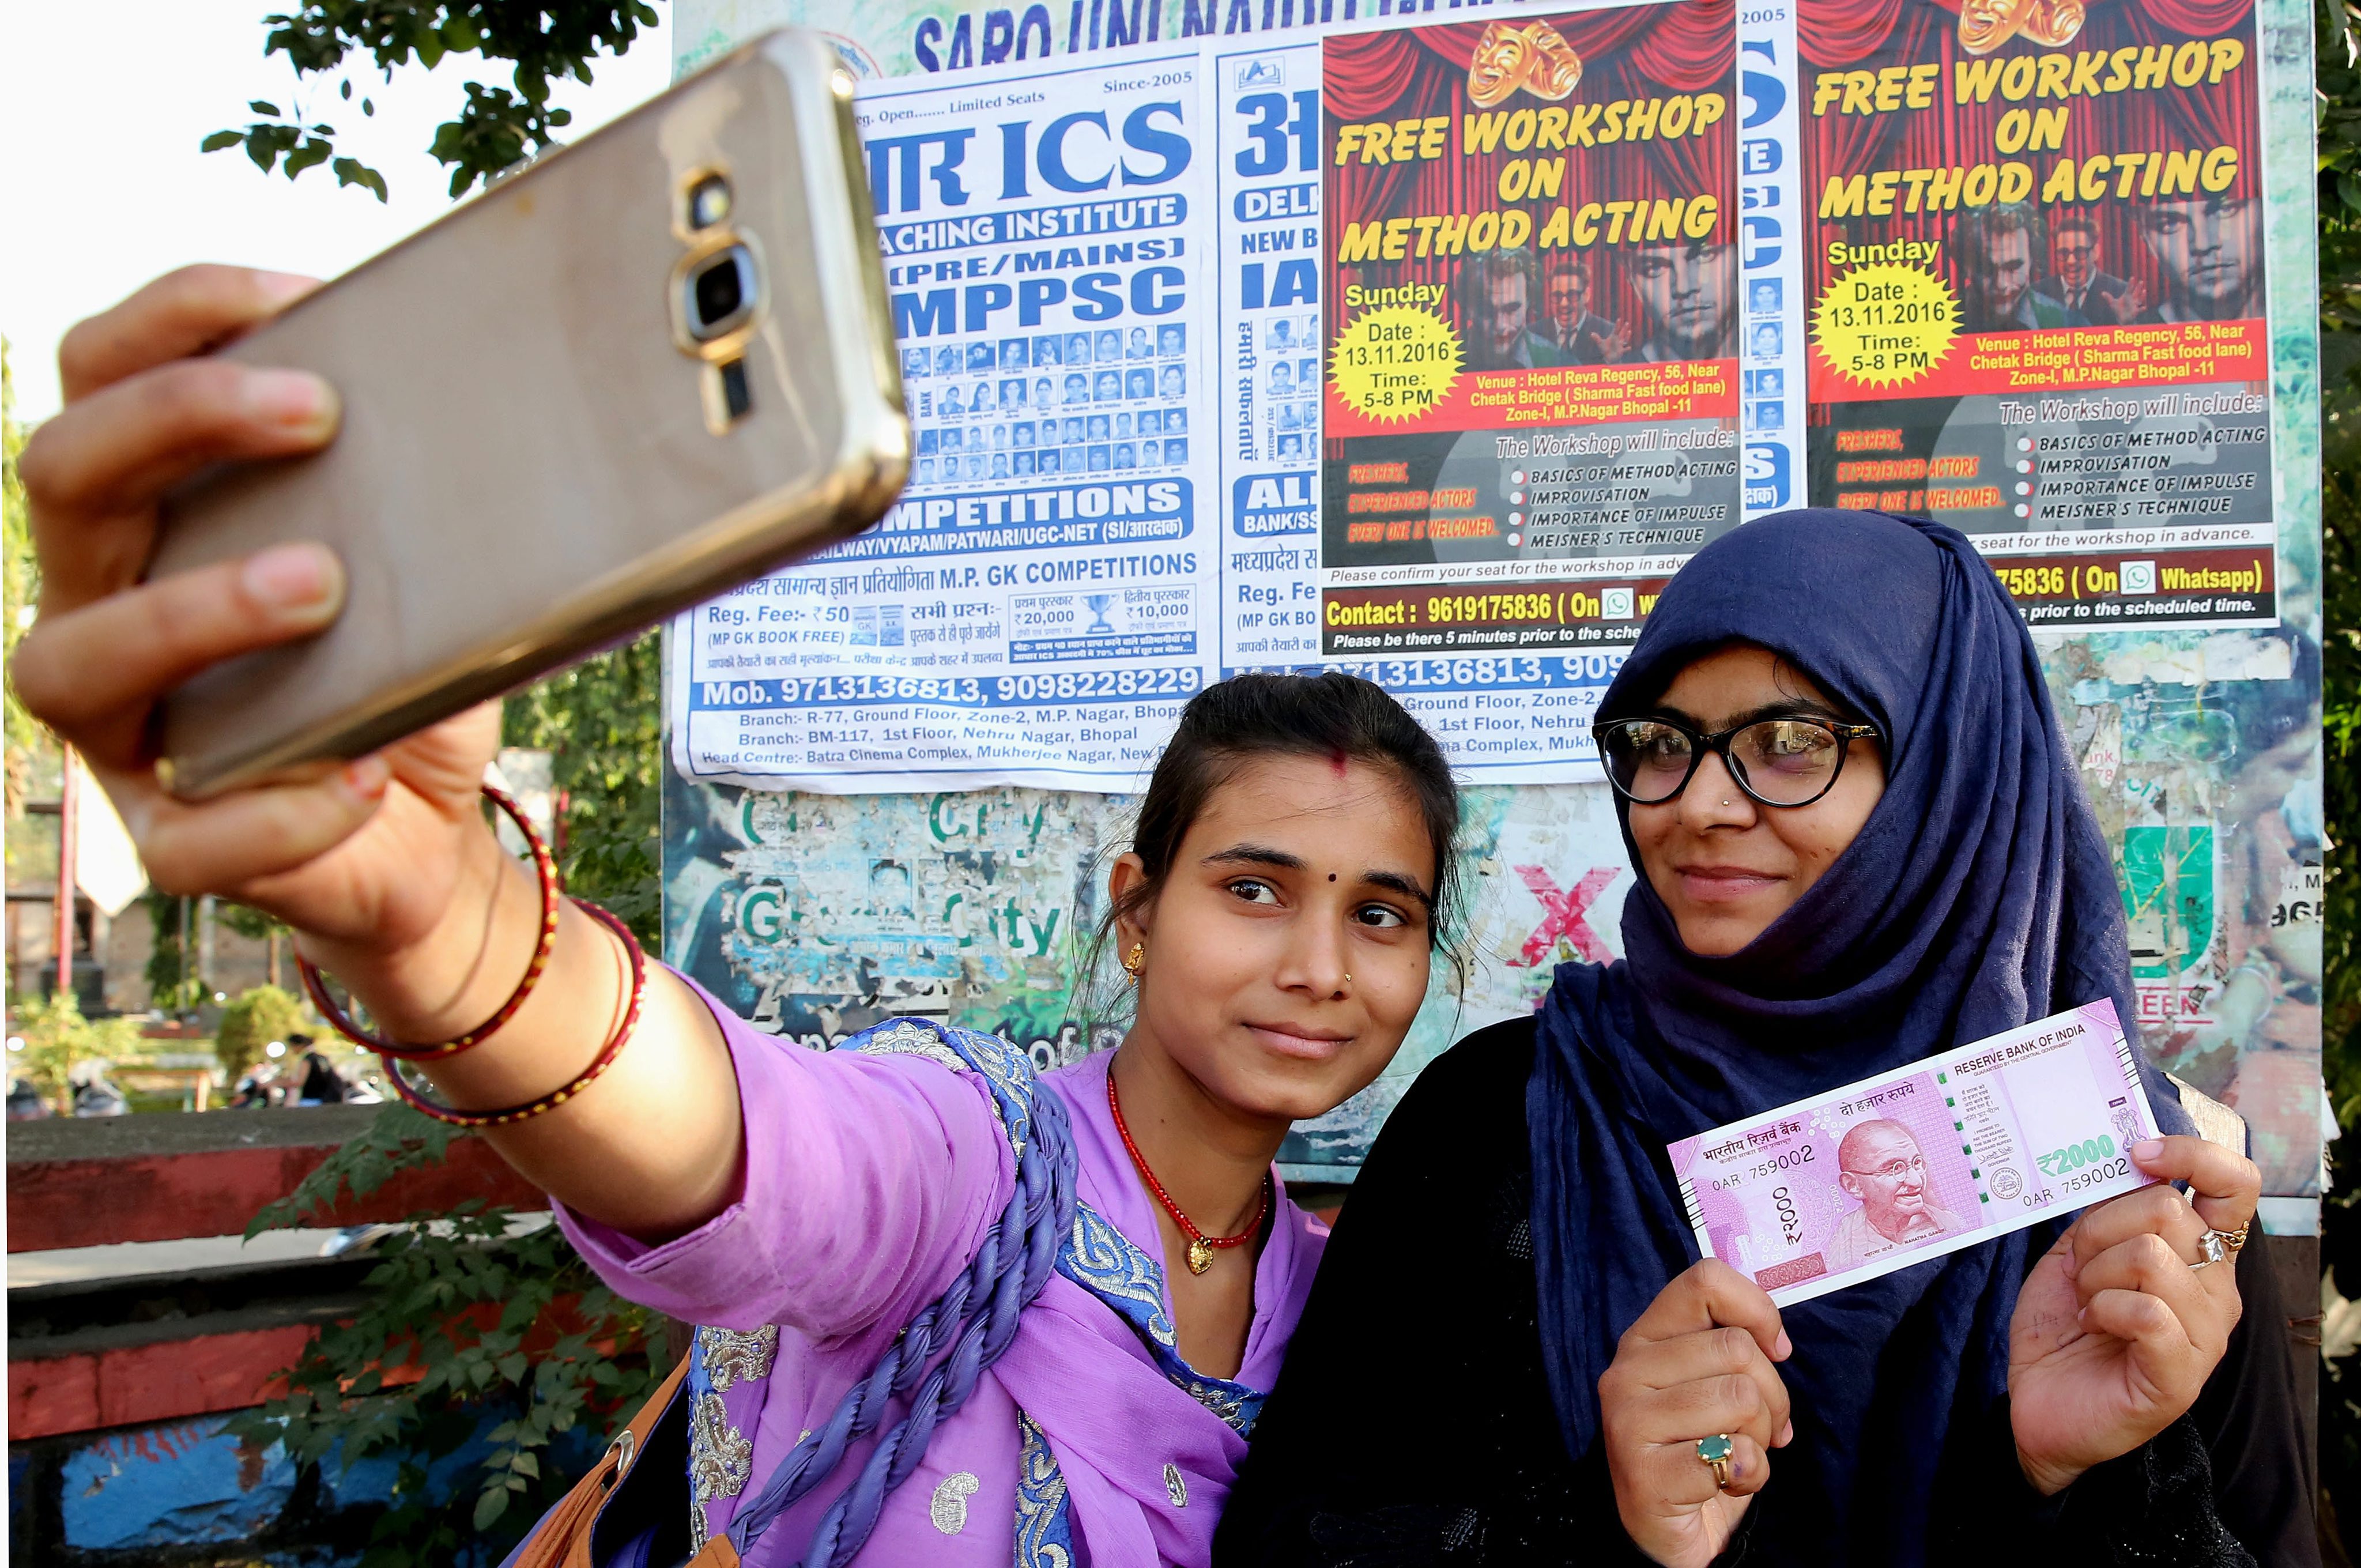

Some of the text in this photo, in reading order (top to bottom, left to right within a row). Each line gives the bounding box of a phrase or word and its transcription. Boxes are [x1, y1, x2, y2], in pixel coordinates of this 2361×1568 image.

[1103, 71, 1193, 93] Since-2005
[1812, 38, 2246, 118] FREE WORKSHOP
[950, 91, 1045, 114] Limited Seats
[1335, 93, 1725, 166] FREE WORKSHOP
[1994, 106, 2070, 154] ON
[997, 100, 1192, 201] ICS
[1498, 157, 1566, 201] ON
[1819, 145, 2239, 220] METHOD ACTING
[1006, 197, 1177, 240] INSTITUTE
[1338, 195, 1719, 263] METHOD ACTING
[1242, 229, 1295, 254] NEW
[1827, 238, 1941, 267] Sunday
[891, 267, 1185, 338] MPPSC
[1345, 281, 1446, 307] Sunday
[1830, 302, 1945, 329] 13.11.2016
[1345, 342, 1450, 367] 13.11.2016
[1370, 372, 1427, 389] Time:
[1476, 364, 1720, 390] Venue Hotel Reva Regency, 56, Near
[920, 391, 932, 417] BANK
[1364, 389, 1434, 407] 5-8 PM
[1470, 380, 1725, 407] Chetak Bridge Sharma Fast food lane)
[1553, 402, 1619, 421] M.P.Nagar
[1622, 399, 1669, 416] Bhopal
[1673, 399, 1692, 412] -11
[1496, 427, 1734, 459] The Workshop will include:
[1531, 461, 1736, 485] BASICS OF METHOD ACTING
[865, 482, 1181, 534] MPETITIONS
[1348, 488, 1477, 513] EXPERIENCED ACTORS
[1532, 488, 1649, 506] IMPROVISATION
[1532, 506, 1725, 527] IMPORTANCE OF IMPULSE
[1531, 529, 1704, 548] MEISNER'S TECHNIQUE
[2075, 527, 2254, 547] workshop advance.
[1231, 544, 1299, 572] मध्यप्रदेश
[830, 575, 858, 600] ज्ञान
[864, 566, 935, 600] प्रतियोगिता
[940, 568, 980, 589] M.P.
[987, 565, 1019, 585] GK
[1025, 553, 1197, 583] COMPETITIONS
[1331, 559, 1653, 583] Please confirm your seat for the workshop in
[2161, 560, 2262, 594] Whatsapp)
[1239, 584, 1283, 606] Reg.
[709, 606, 806, 625] Reg. Fee:-
[911, 601, 946, 619] सभी
[1327, 592, 1600, 627] Contact 9619175836 On
[2030, 597, 2256, 622] prior scheduled time.
[708, 631, 844, 647] (MP GK BOOK FREE)
[1333, 625, 1602, 649] Please be there 5 minutes prior to the
[703, 668, 1200, 707] Mob. 9713136813, 9098228229
[1405, 695, 1469, 711] Ground
[740, 706, 1130, 726] Branch:- R-77, Ground Floor, Zone-2, M.P. Nagar,
[1531, 716, 1585, 729] Nehru
[739, 726, 1137, 745] Branch:- BM-117, 1st Floor, Nehru Nagar, Bhopal
[703, 745, 1062, 764] Head Centre:- Batra Cinema Complex, Mukherjee
[1955, 1024, 2086, 1076] RESERVE BANK OF INDIA
[2041, 1040, 2072, 1054] GOVERNMENT
[1840, 1102, 1854, 1117] दो
[1887, 1081, 1915, 1102] रुपये
[1703, 1138, 1745, 1161] भारतीय
[1749, 1145, 1815, 1179] 759002
[2062, 1158, 2130, 1194] 759002
